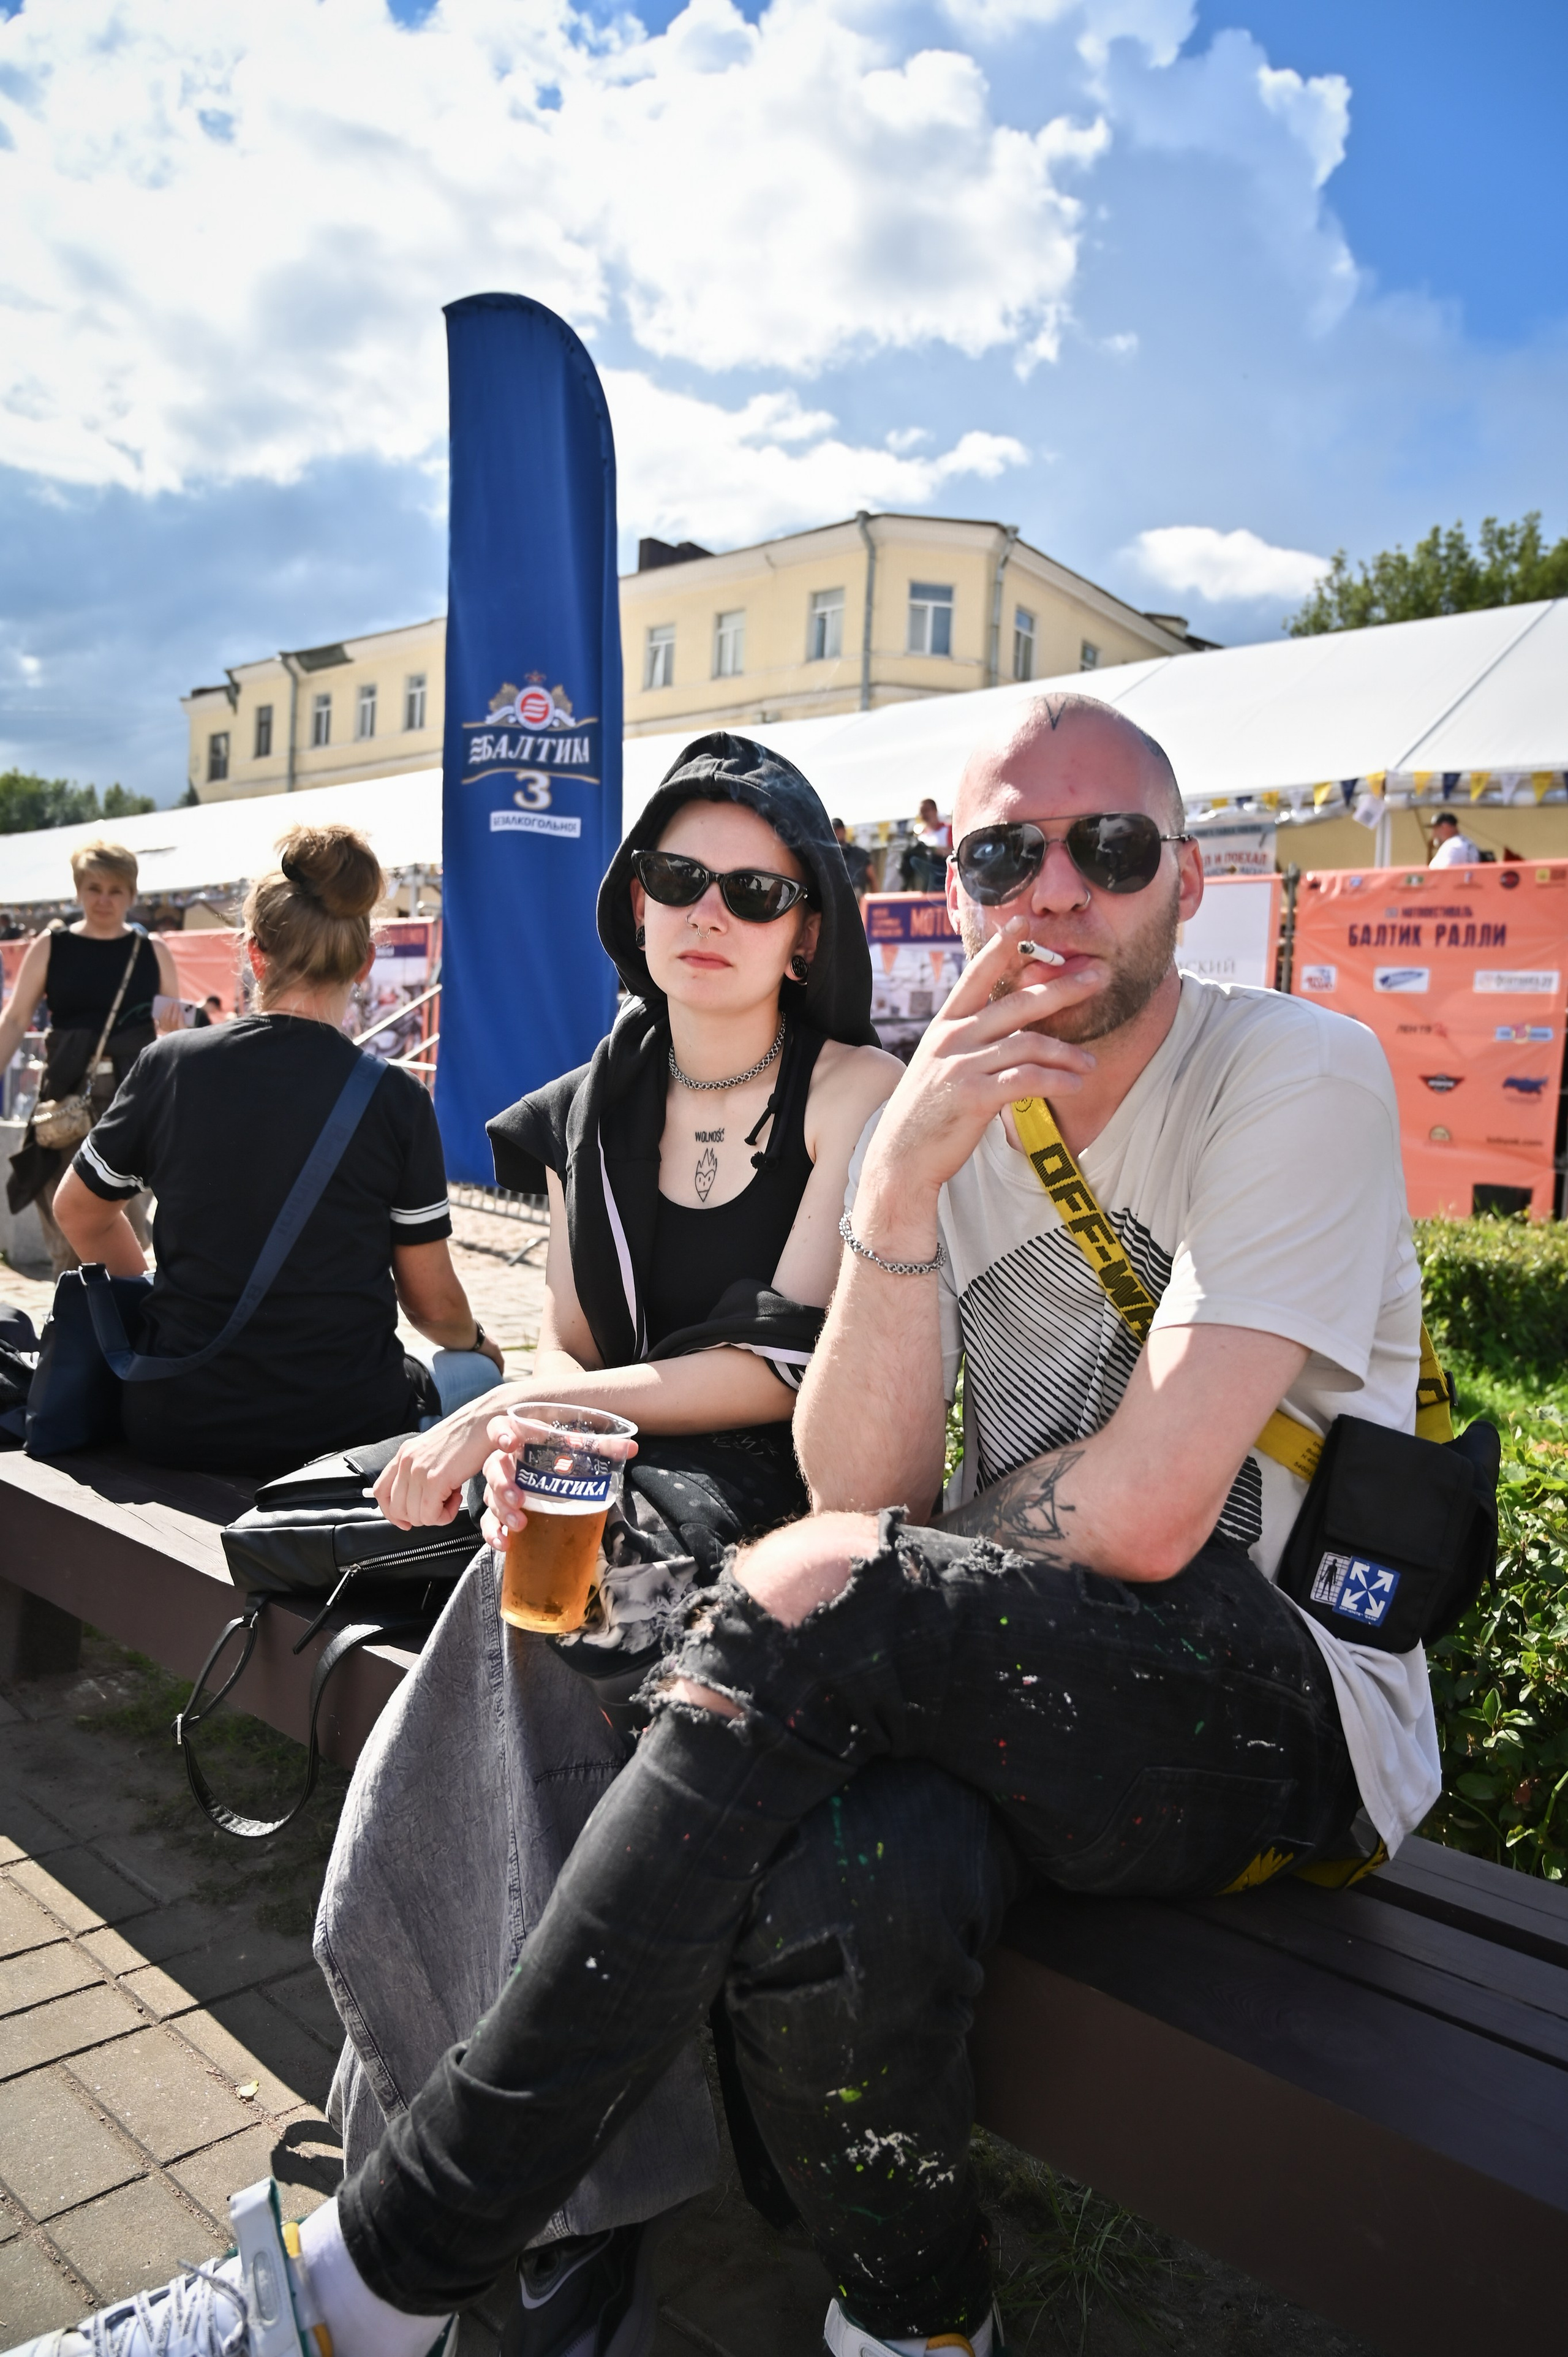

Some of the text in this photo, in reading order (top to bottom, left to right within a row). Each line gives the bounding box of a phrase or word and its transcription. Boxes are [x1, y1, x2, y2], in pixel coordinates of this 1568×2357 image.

[468, 734, 590, 765] БАЛТИКА
[514, 770, 552, 810] 3
[1349, 923, 1507, 947] БАЛТИК РАЛЛИ
[518, 1469, 606, 1496] БАЛТИКА
